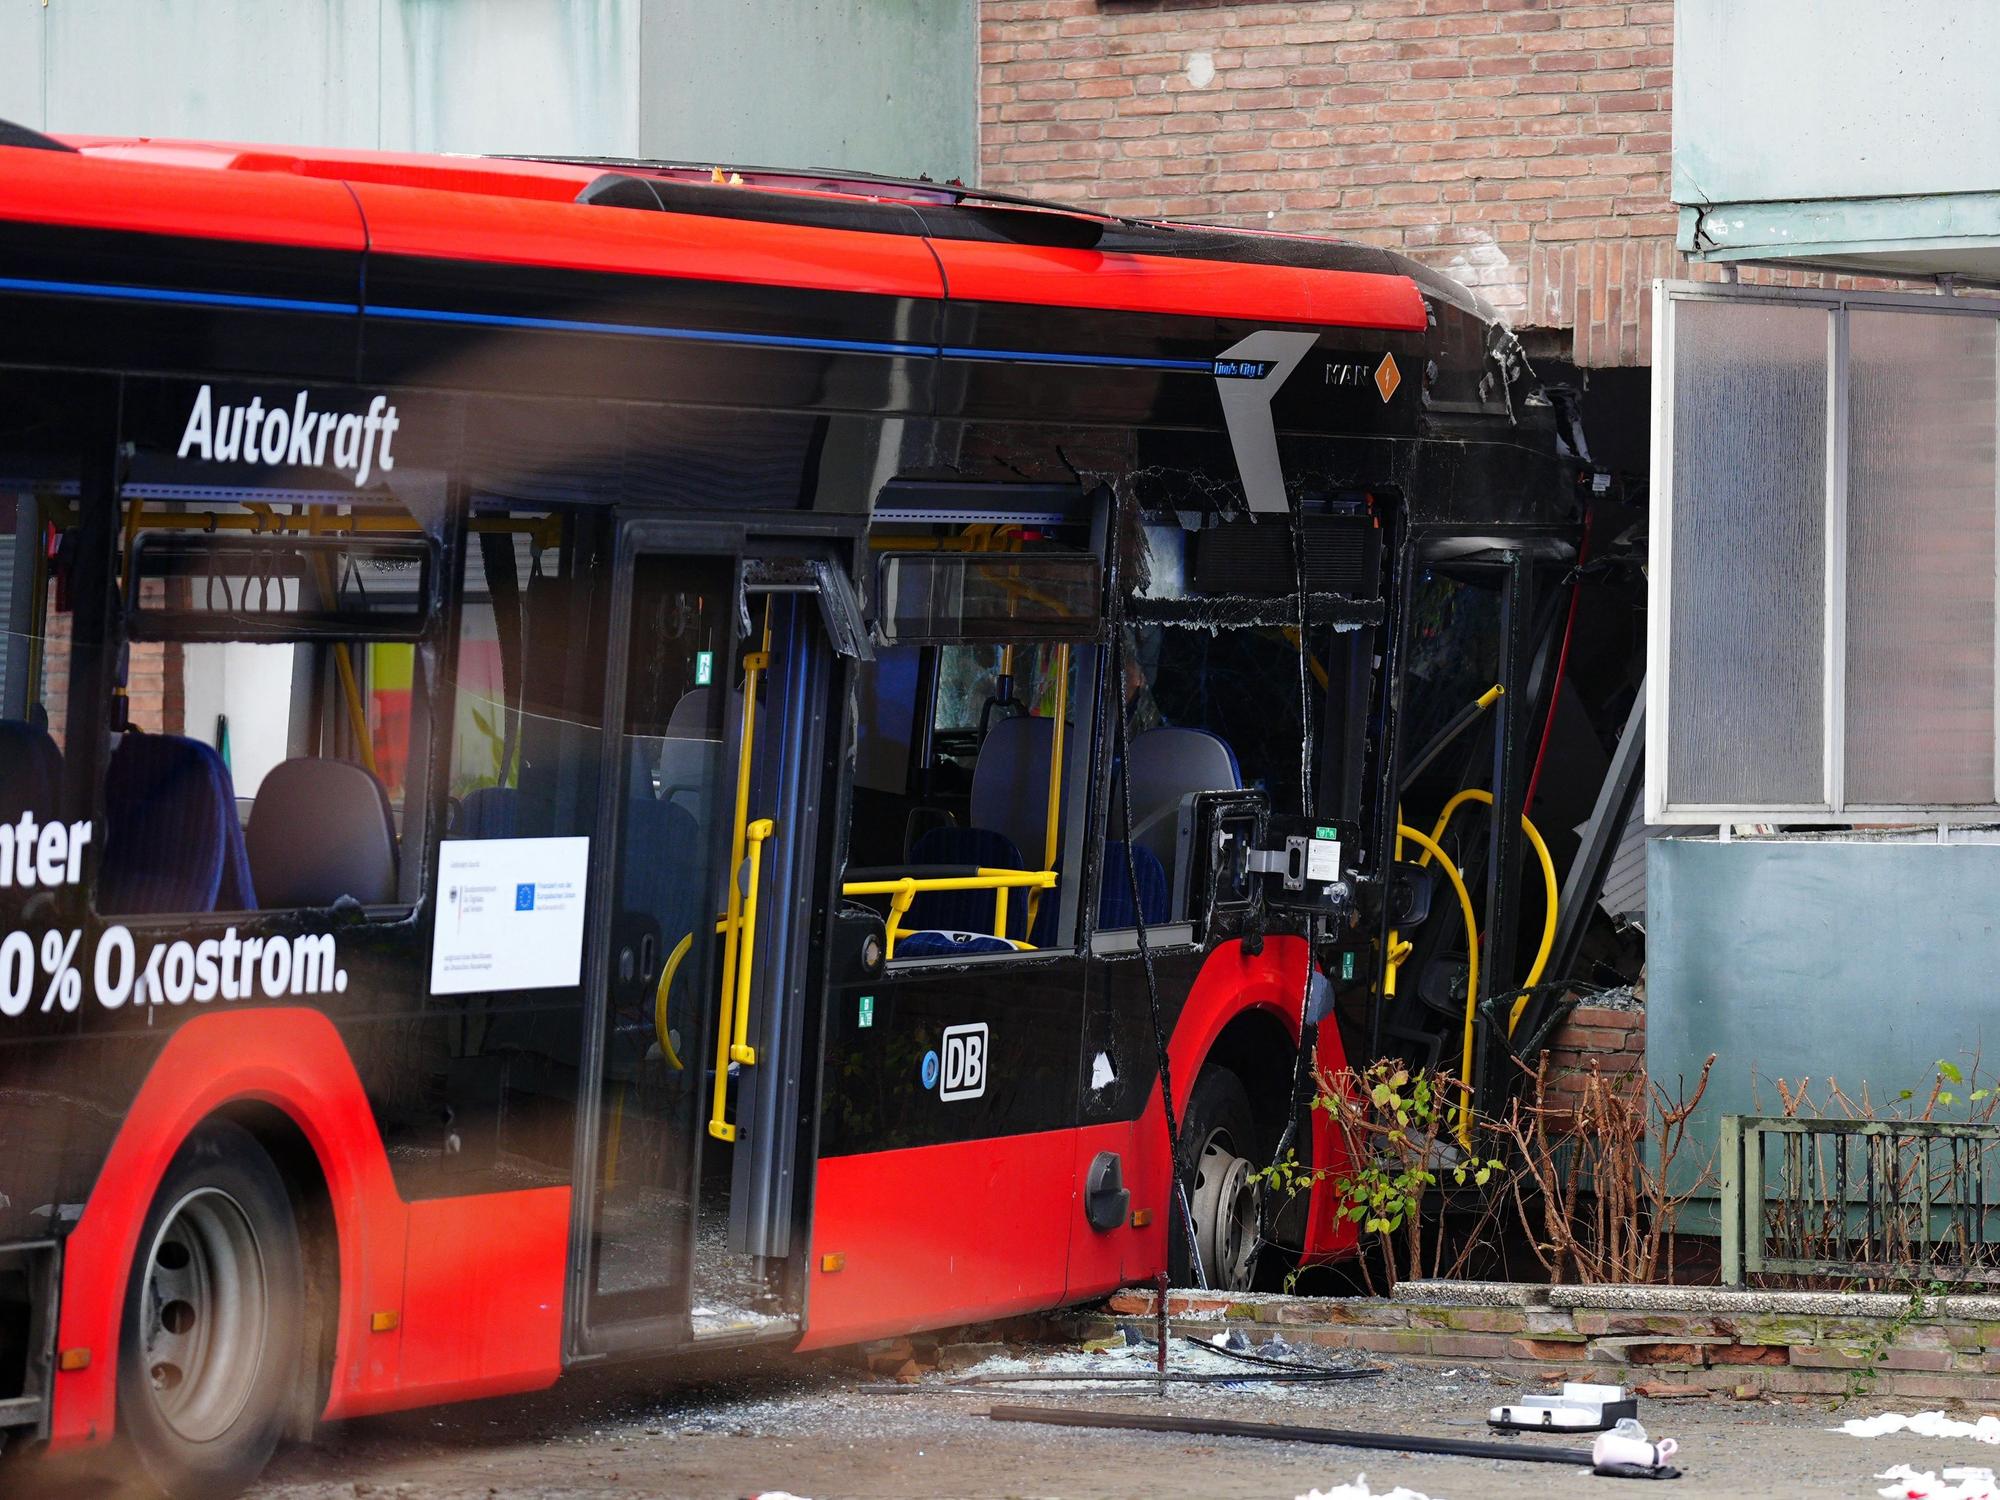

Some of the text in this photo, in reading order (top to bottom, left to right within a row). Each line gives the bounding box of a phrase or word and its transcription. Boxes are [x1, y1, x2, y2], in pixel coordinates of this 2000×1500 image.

[1325, 363, 1370, 386] MAN
[177, 384, 400, 488] Autokraft
[946, 1035, 982, 1089] DB
